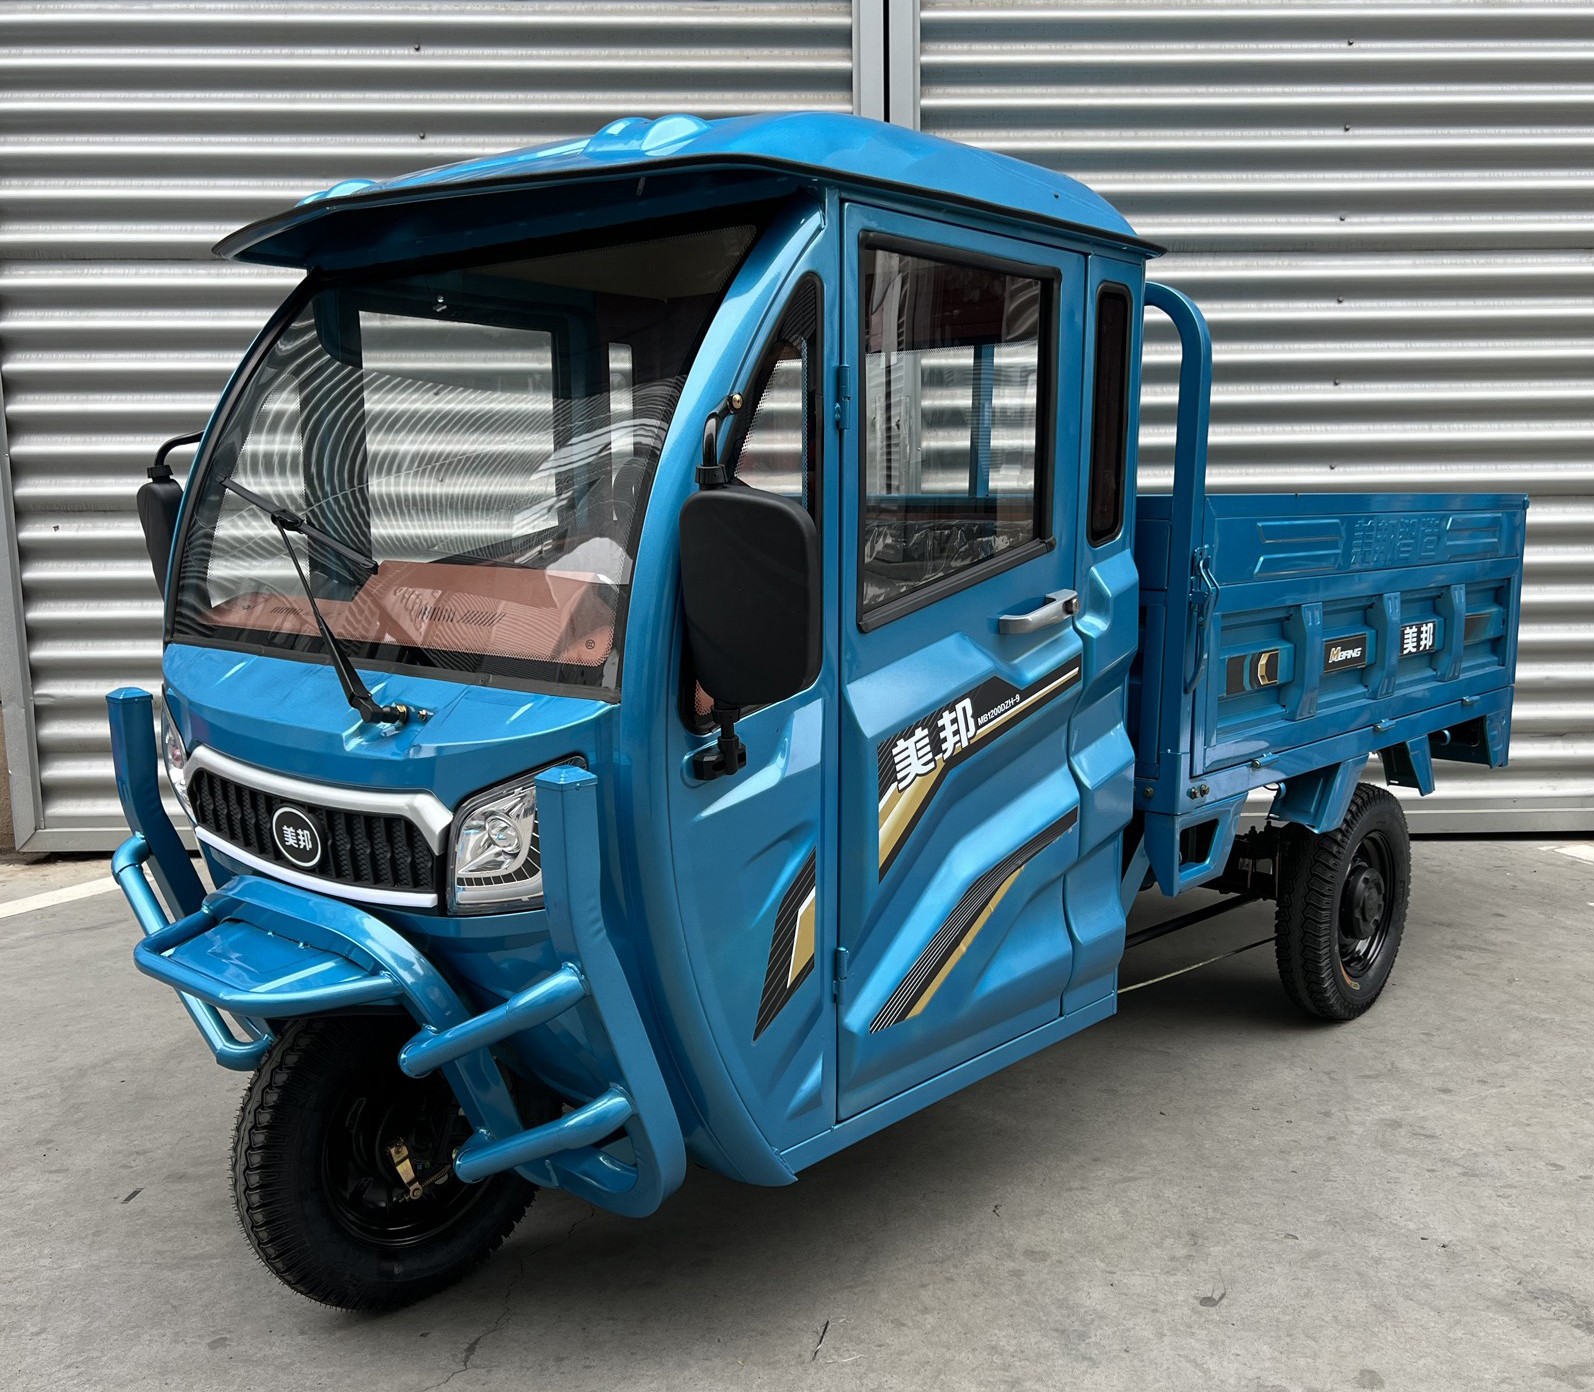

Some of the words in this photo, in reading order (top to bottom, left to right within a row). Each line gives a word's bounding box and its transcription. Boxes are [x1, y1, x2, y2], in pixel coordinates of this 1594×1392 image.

[1403, 622, 1433, 655] 美邦
[977, 693, 1020, 726] MB1200DZH-9
[891, 697, 976, 791] 美邦
[282, 824, 313, 851] 美邦
